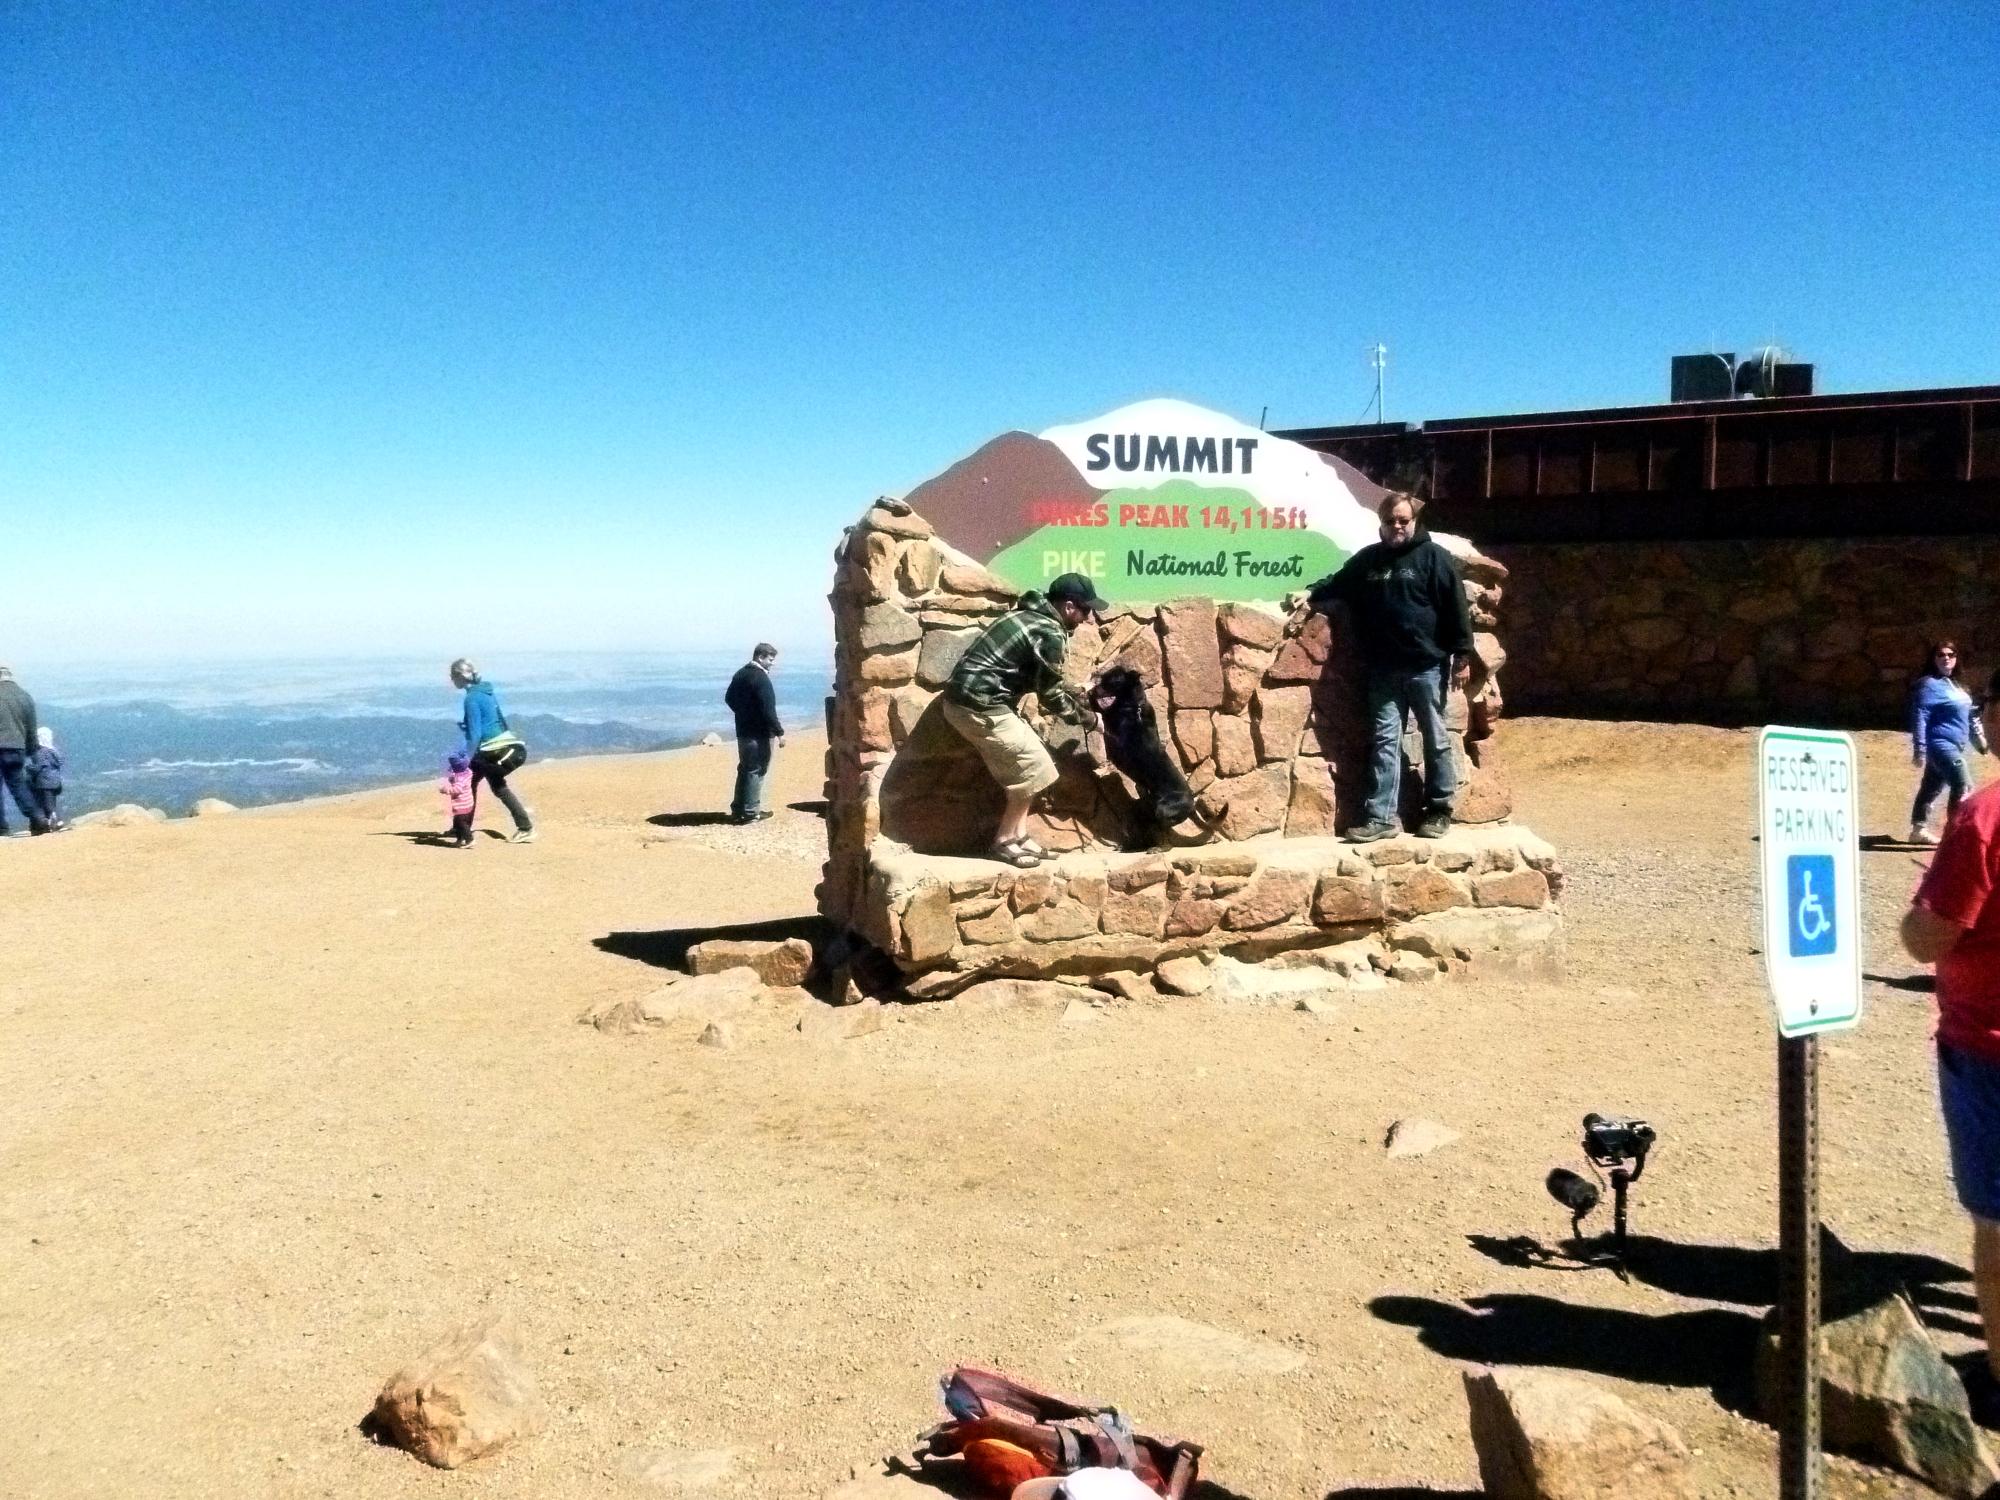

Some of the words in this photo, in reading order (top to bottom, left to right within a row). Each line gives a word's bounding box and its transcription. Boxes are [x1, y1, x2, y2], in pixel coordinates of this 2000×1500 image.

[1087, 433, 1258, 474] SUMMIT
[1032, 503, 1109, 527] IKES
[1119, 504, 1189, 528] PEAK
[1200, 506, 1307, 534] 14,115ft
[1043, 550, 1106, 577] PIKE
[1127, 550, 1228, 577] National
[1234, 551, 1304, 577] Forest
[1768, 756, 1848, 793] RESERVED
[1775, 808, 1845, 843] PARKING
